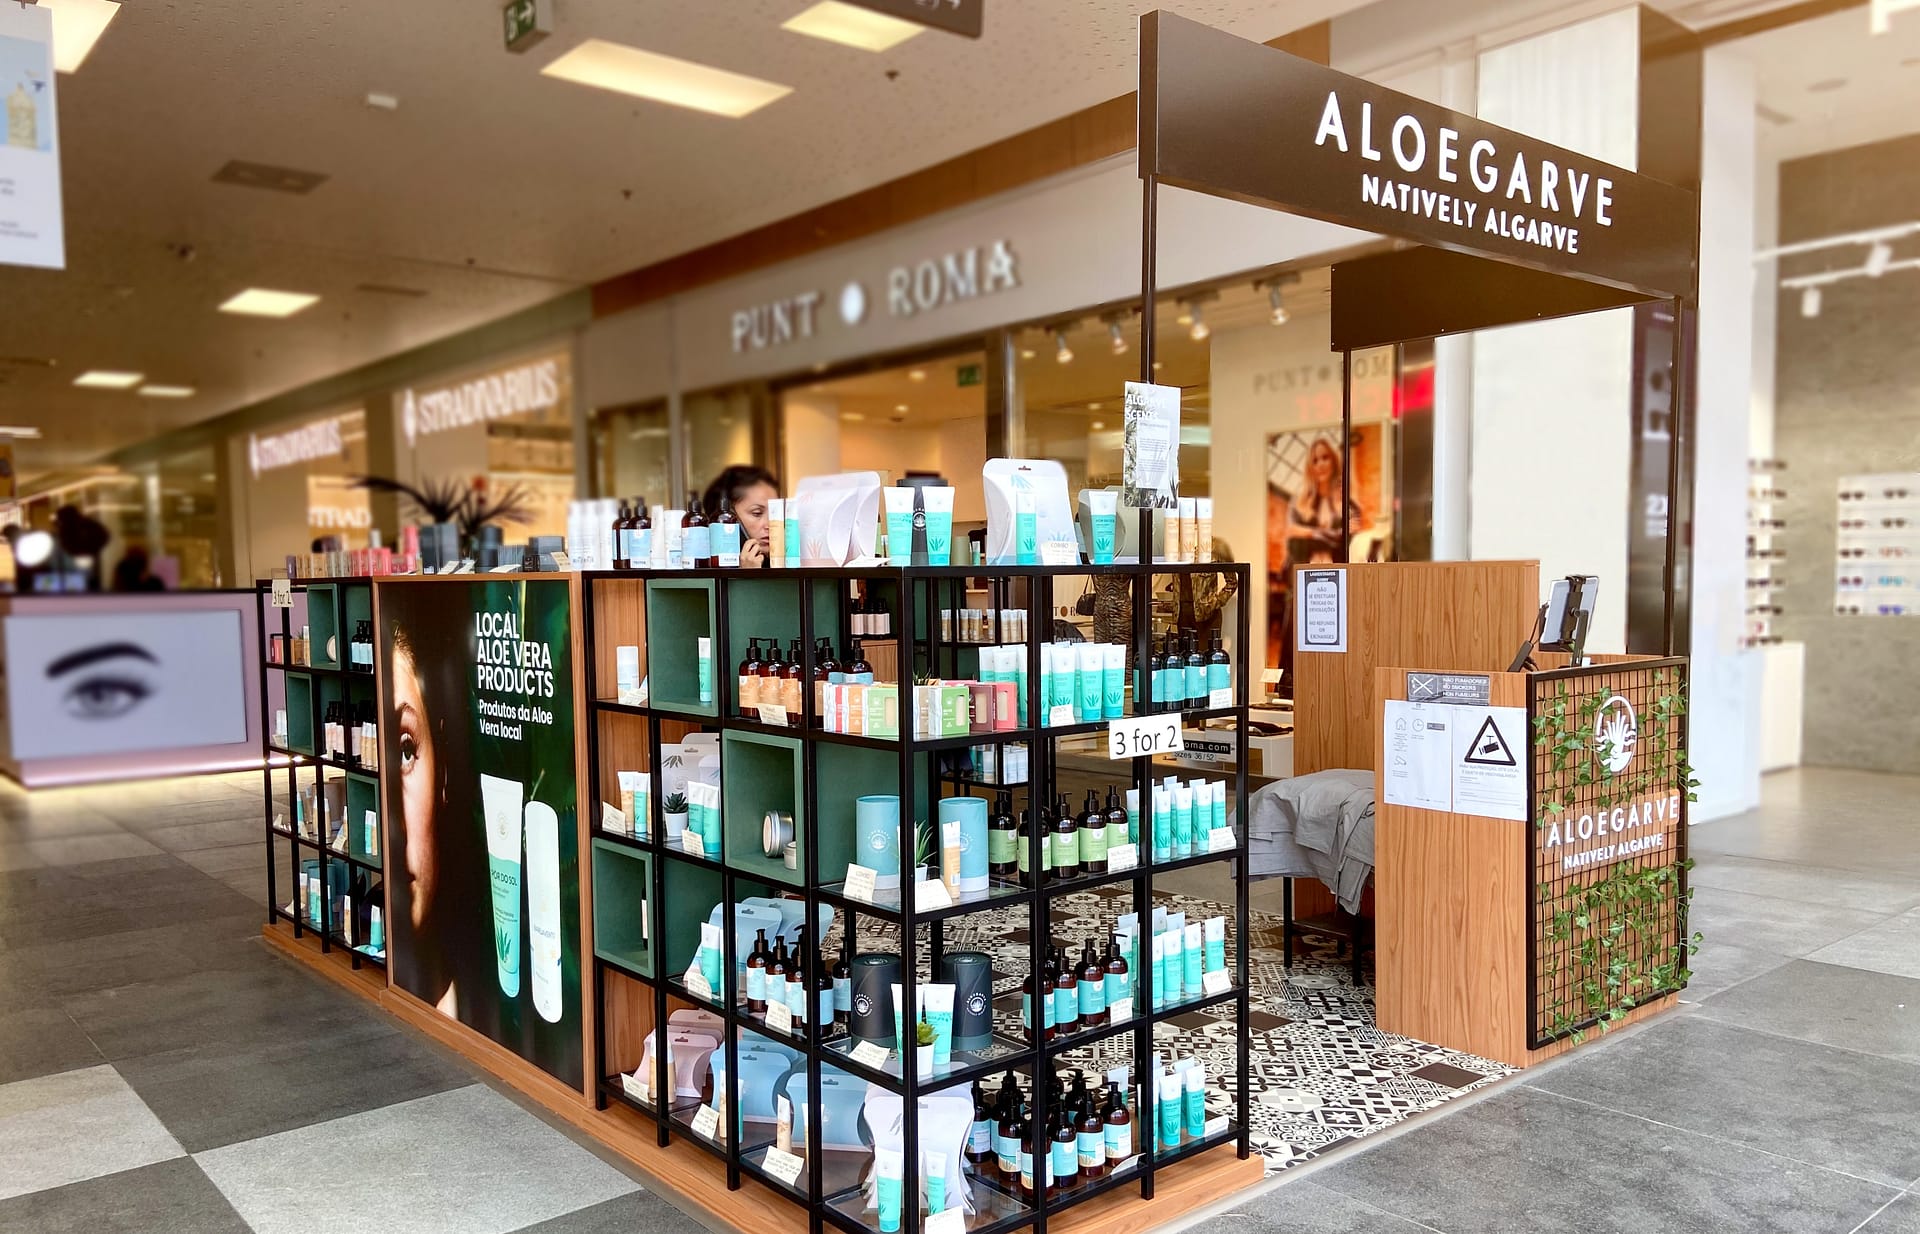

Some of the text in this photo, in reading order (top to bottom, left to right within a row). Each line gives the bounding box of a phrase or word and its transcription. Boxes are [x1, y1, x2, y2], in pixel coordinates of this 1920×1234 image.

[1314, 90, 1614, 227] ALOEGARVE
[1362, 173, 1579, 254] NATIVELY ALGARVE
[732, 239, 1018, 352] PUNT ROMA
[476, 611, 520, 639] LOCAL
[477, 639, 552, 670] ALOE VERA
[477, 664, 554, 698] PRODUCTS
[479, 699, 553, 725] Produtos da Aloe
[479, 718, 522, 741] Vera local
[1115, 725, 1178, 755] 3 for 2
[1184, 741, 1229, 753] oma.com
[1547, 795, 1679, 848] ALOEGARVE
[1564, 833, 1664, 870] NATIVELY ALGARVE
